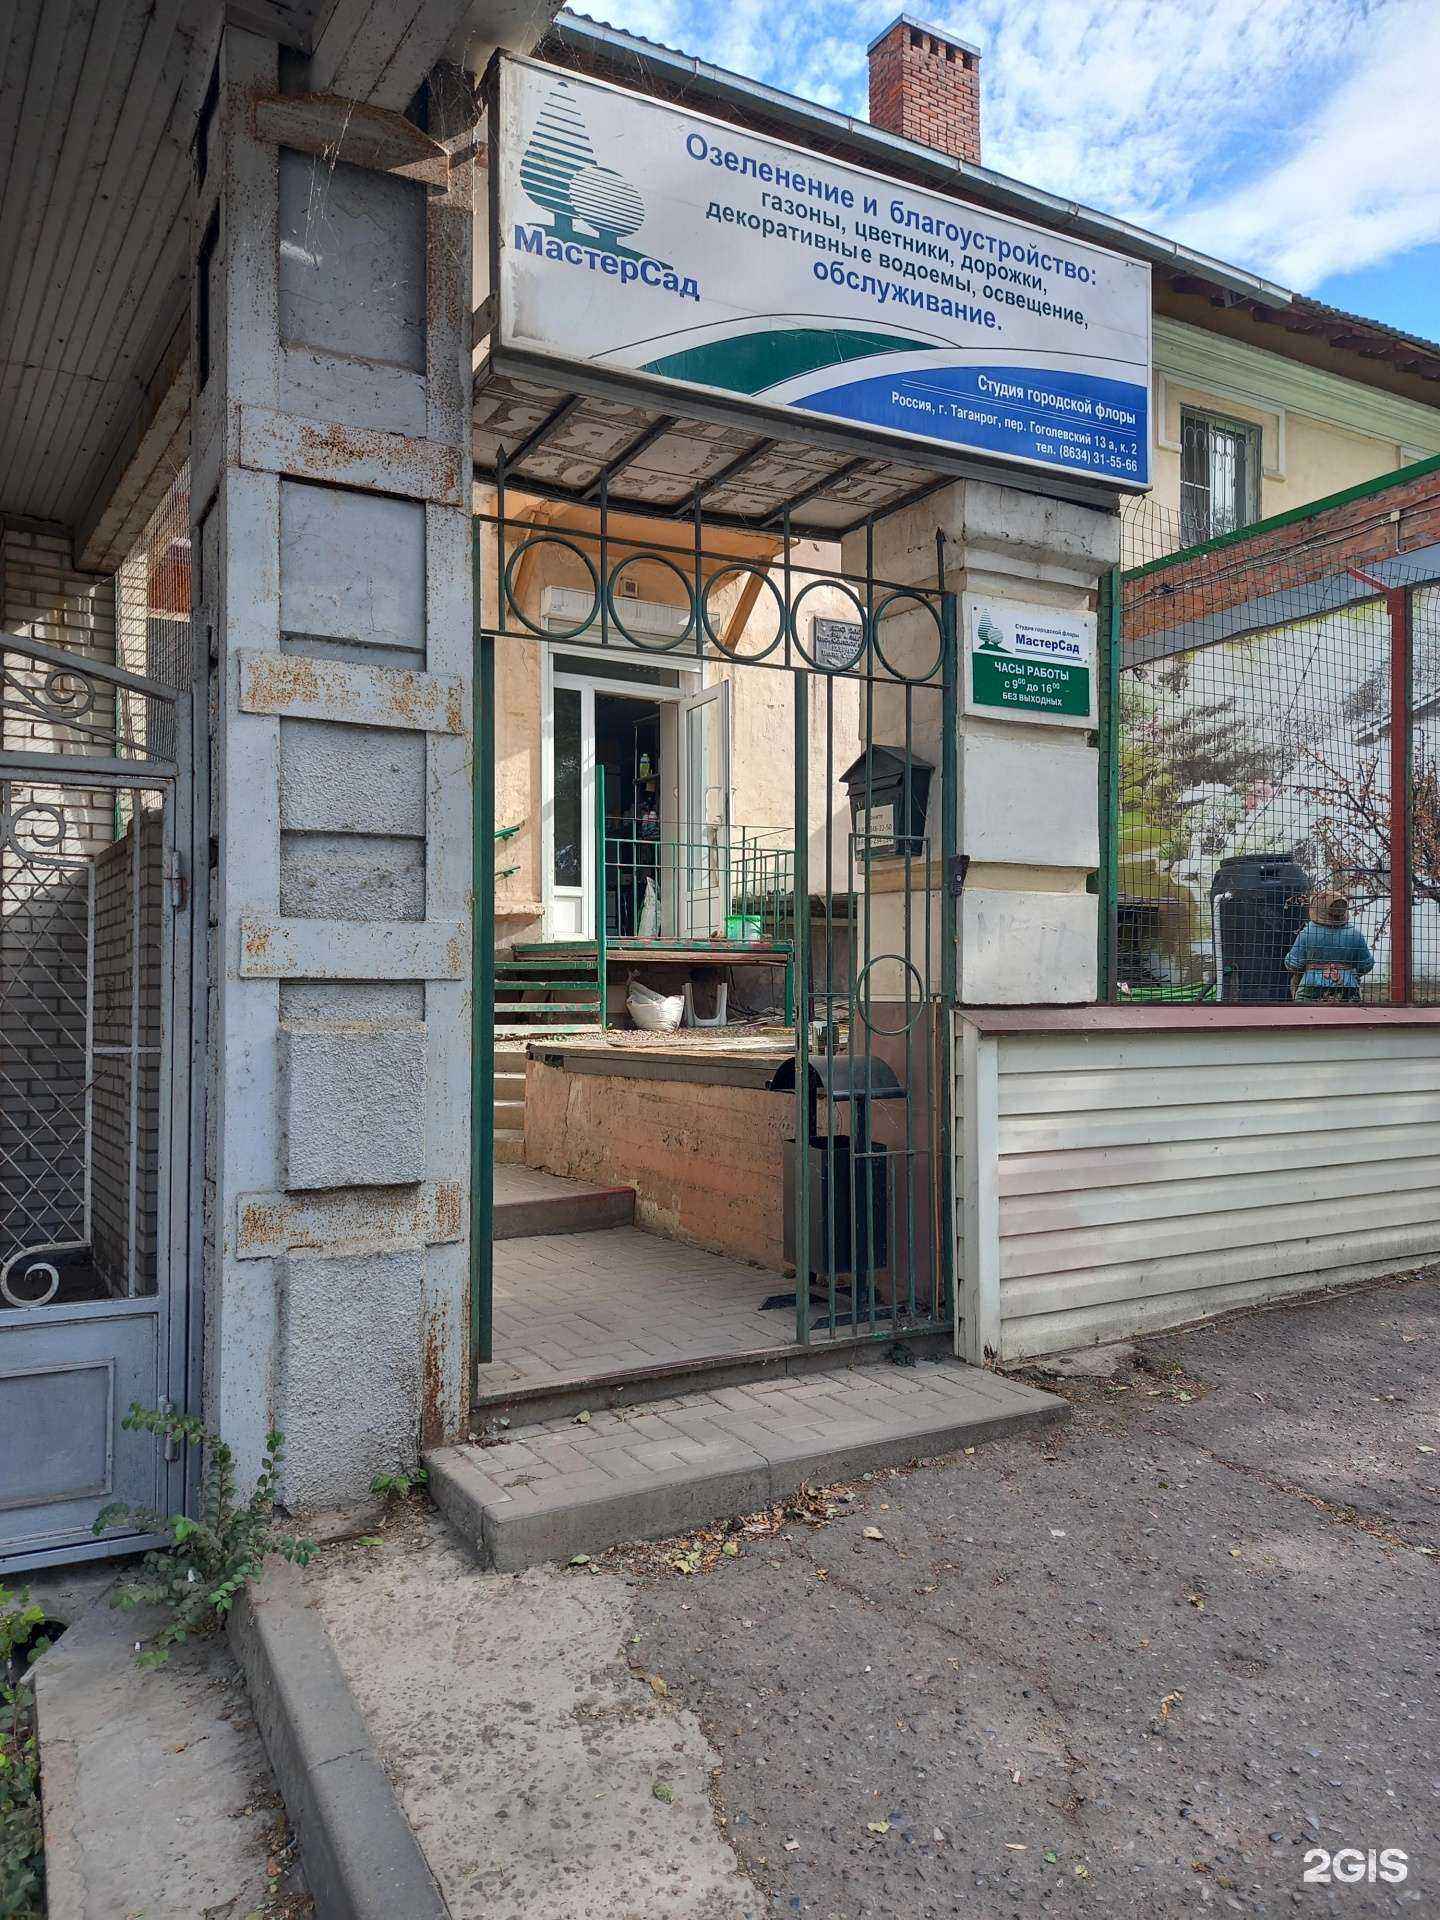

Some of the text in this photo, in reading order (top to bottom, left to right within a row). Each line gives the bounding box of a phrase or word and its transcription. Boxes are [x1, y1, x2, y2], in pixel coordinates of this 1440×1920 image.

[686, 133, 1096, 286] Озеленение и благоустройство:
[514, 224, 700, 302] МастерСад
[706, 202, 1088, 330] декоративные водоемы, освещение,
[761, 192, 1047, 295] газоны, цветники, дорожки,
[813, 260, 1002, 330] обслуживание.
[892, 391, 935, 415] Россия,
[939, 405, 948, 415] г.
[951, 404, 1002, 429] Таганрог,
[1004, 418, 1027, 433] пер.
[1030, 421, 1092, 446] Гоголевский
[1094, 435, 1106, 449] 13
[1120, 443, 1129, 453] к.
[1131, 443, 1138, 455] 2
[978, 374, 1136, 425] Студия городской флоры
[1035, 442, 1138, 472] тел. (8634) 31-55-66
[994, 661, 1069, 681] ЧАСЫ РАБОТЫ
[1015, 633, 1080, 655] МастерСад
[1002, 691, 1063, 707] БЕЗ ВЫХОДНЫХ
[1026, 683, 1039, 692] до
